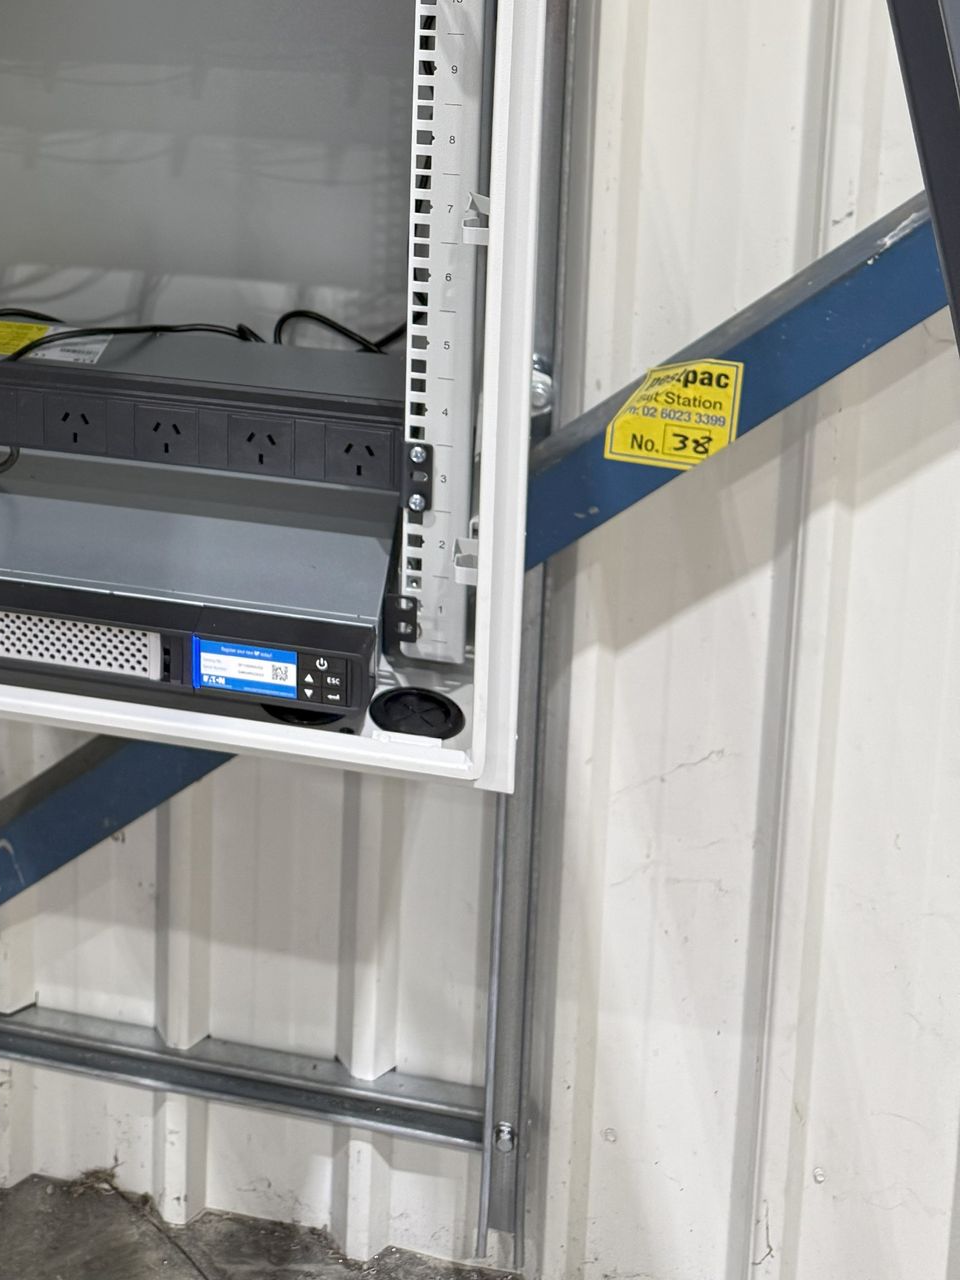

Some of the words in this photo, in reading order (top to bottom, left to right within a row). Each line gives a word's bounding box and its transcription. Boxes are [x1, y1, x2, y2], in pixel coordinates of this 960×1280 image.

[451, 65, 458, 75] 9
[448, 135, 456, 145] 8
[447, 204, 454, 214] 7
[445, 272, 452, 282] 6
[443, 341, 451, 351] 5
[664, 391, 723, 410] Station
[441, 407, 449, 417] 4
[642, 405, 657, 418] 02
[661, 408, 691, 422] 6023
[630, 433, 660, 453] No.
[672, 433, 713, 454] 38
[440, 474, 447, 484] 3
[438, 540, 446, 550] 2
[203, 675, 226, 685] EATON
[327, 677, 340, 685] ESC
